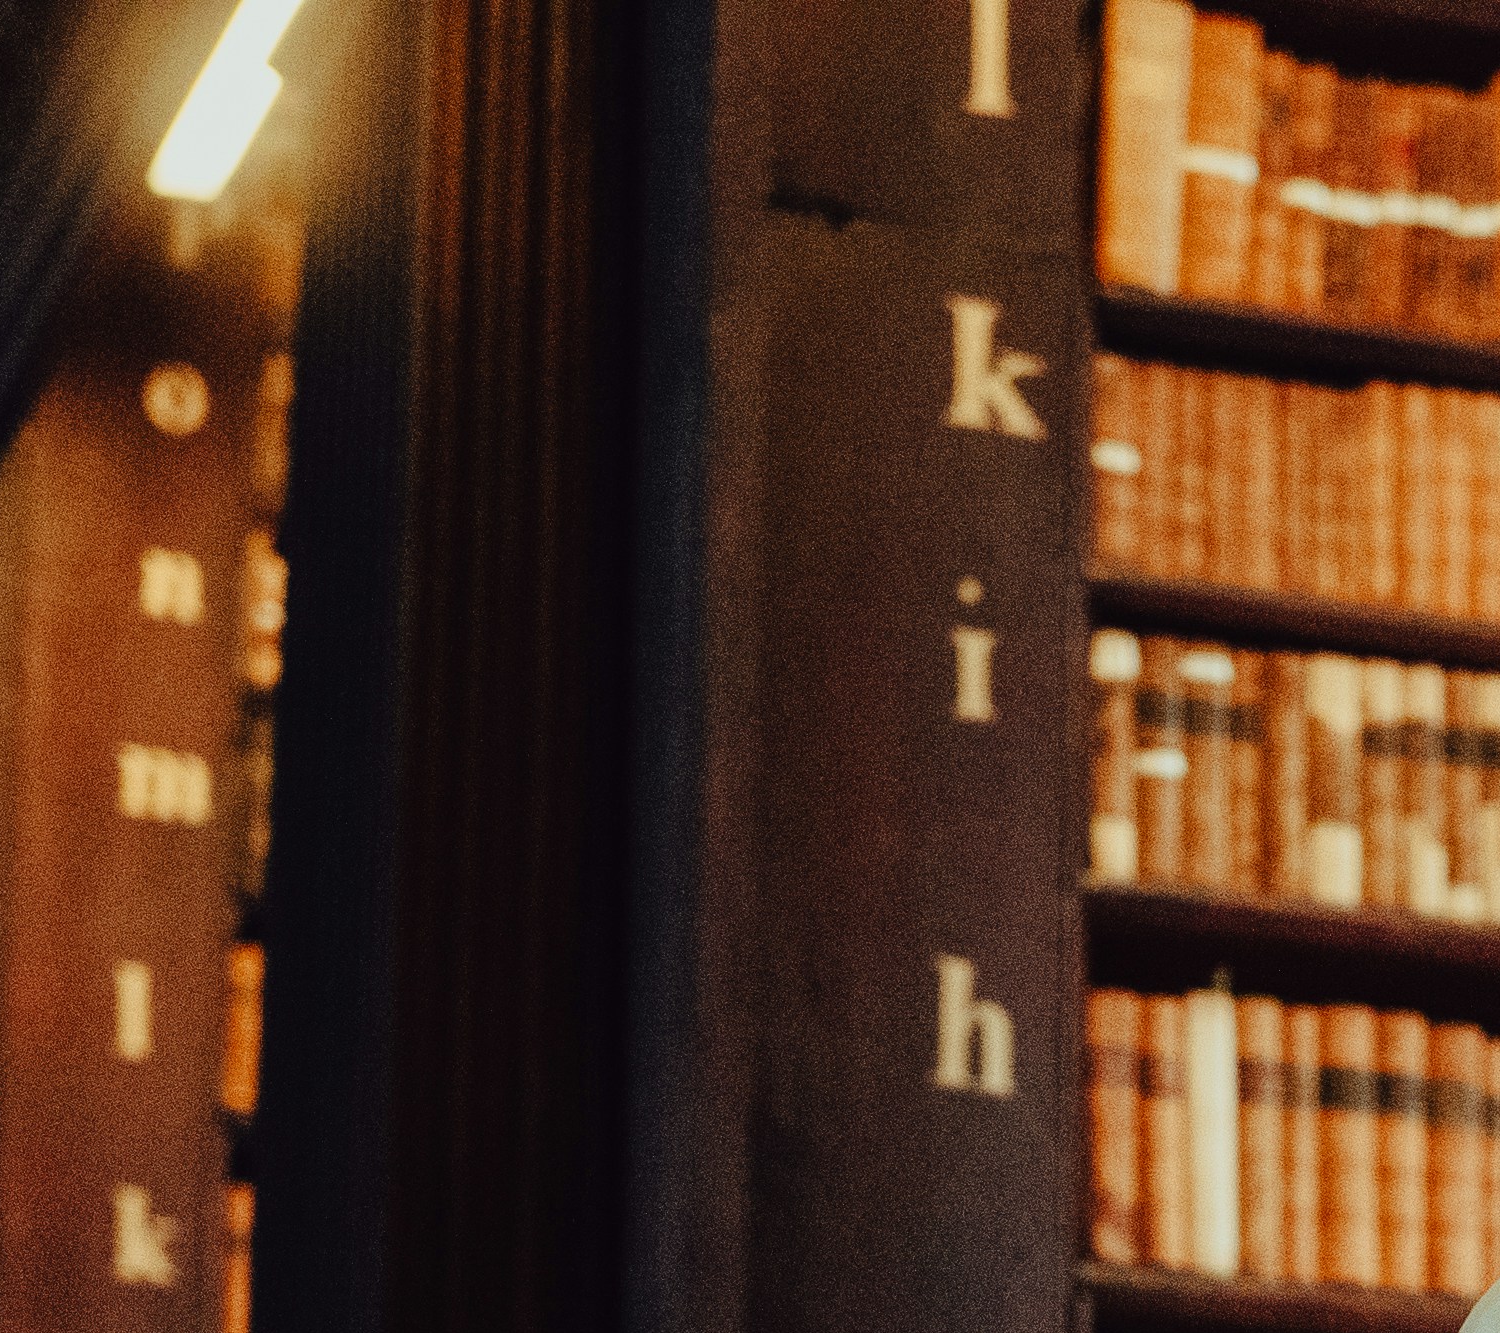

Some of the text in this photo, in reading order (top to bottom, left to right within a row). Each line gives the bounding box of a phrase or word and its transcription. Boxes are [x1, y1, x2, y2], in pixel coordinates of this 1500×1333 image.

[946, 296, 1047, 440] k
[952, 575, 997, 723] i
[117, 741, 212, 828] m
[113, 959, 154, 1064] l
[934, 954, 1018, 1098] h
[113, 1184, 178, 1287] k
